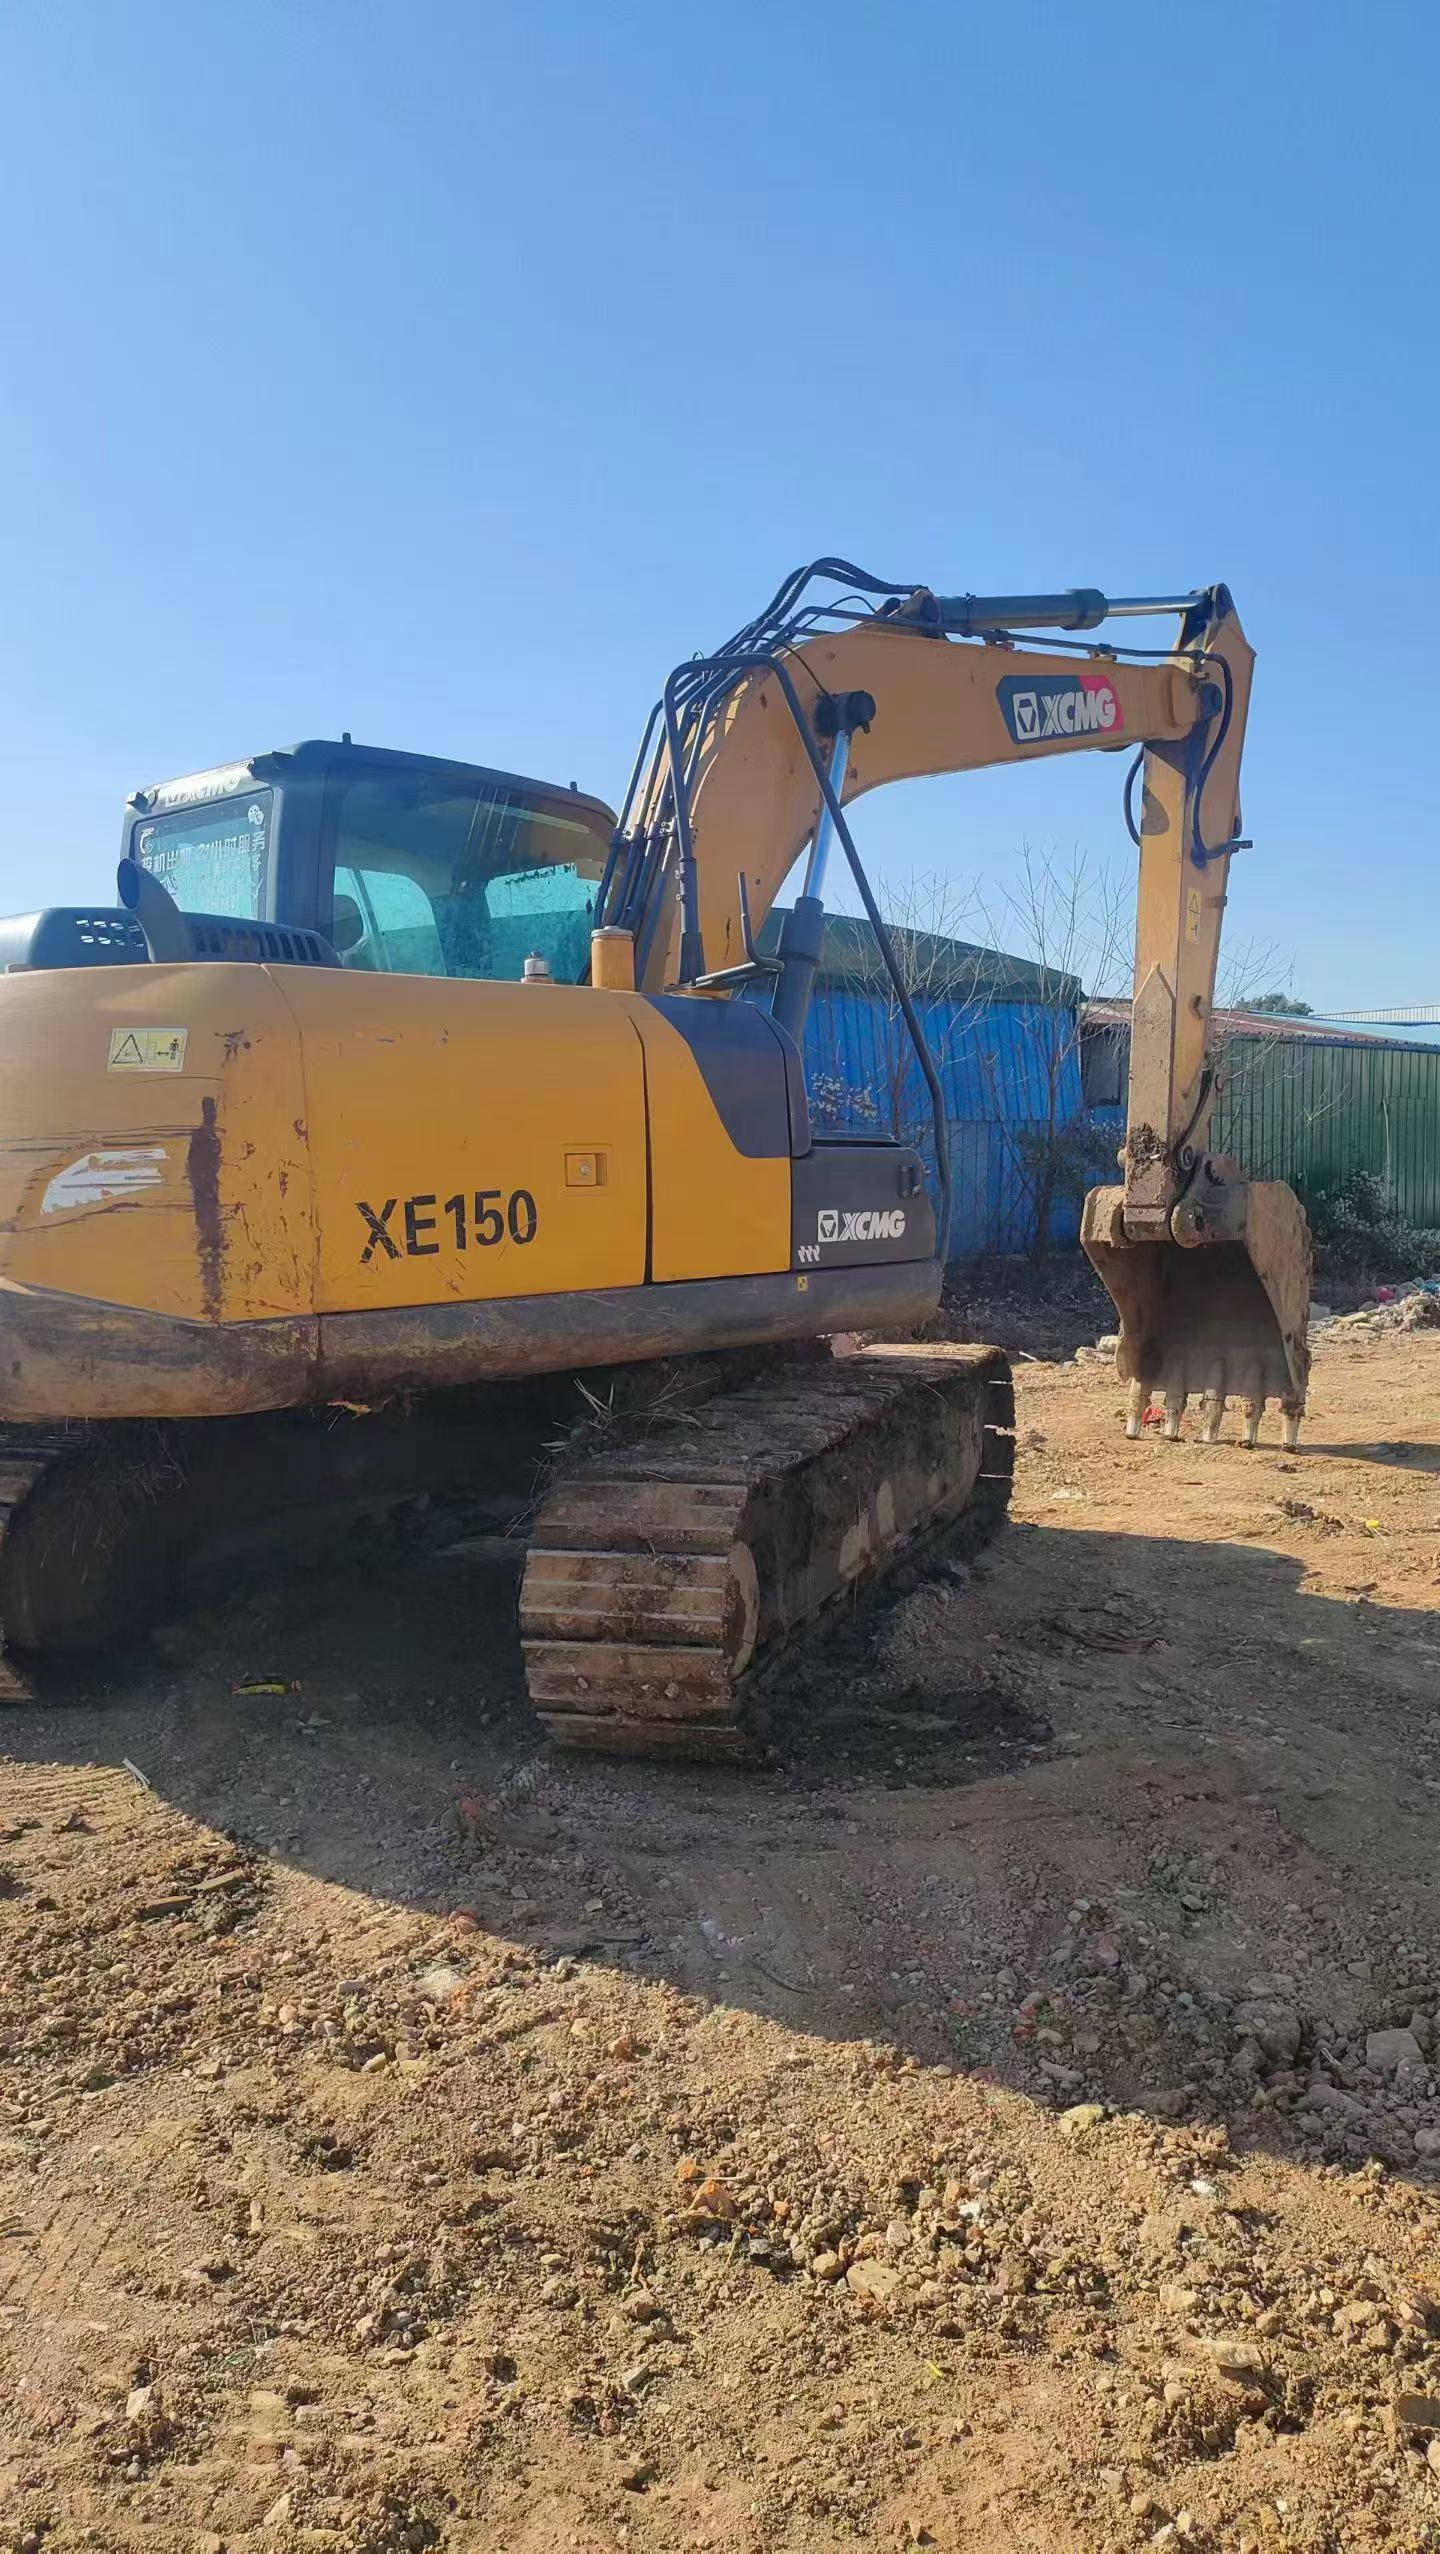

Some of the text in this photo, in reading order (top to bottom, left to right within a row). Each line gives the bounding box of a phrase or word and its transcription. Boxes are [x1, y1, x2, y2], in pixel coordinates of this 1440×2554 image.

[1040, 687, 1116, 737] XCMG
[354, 1188, 538, 1263] XE150
[838, 1209, 906, 1241] XCMG
